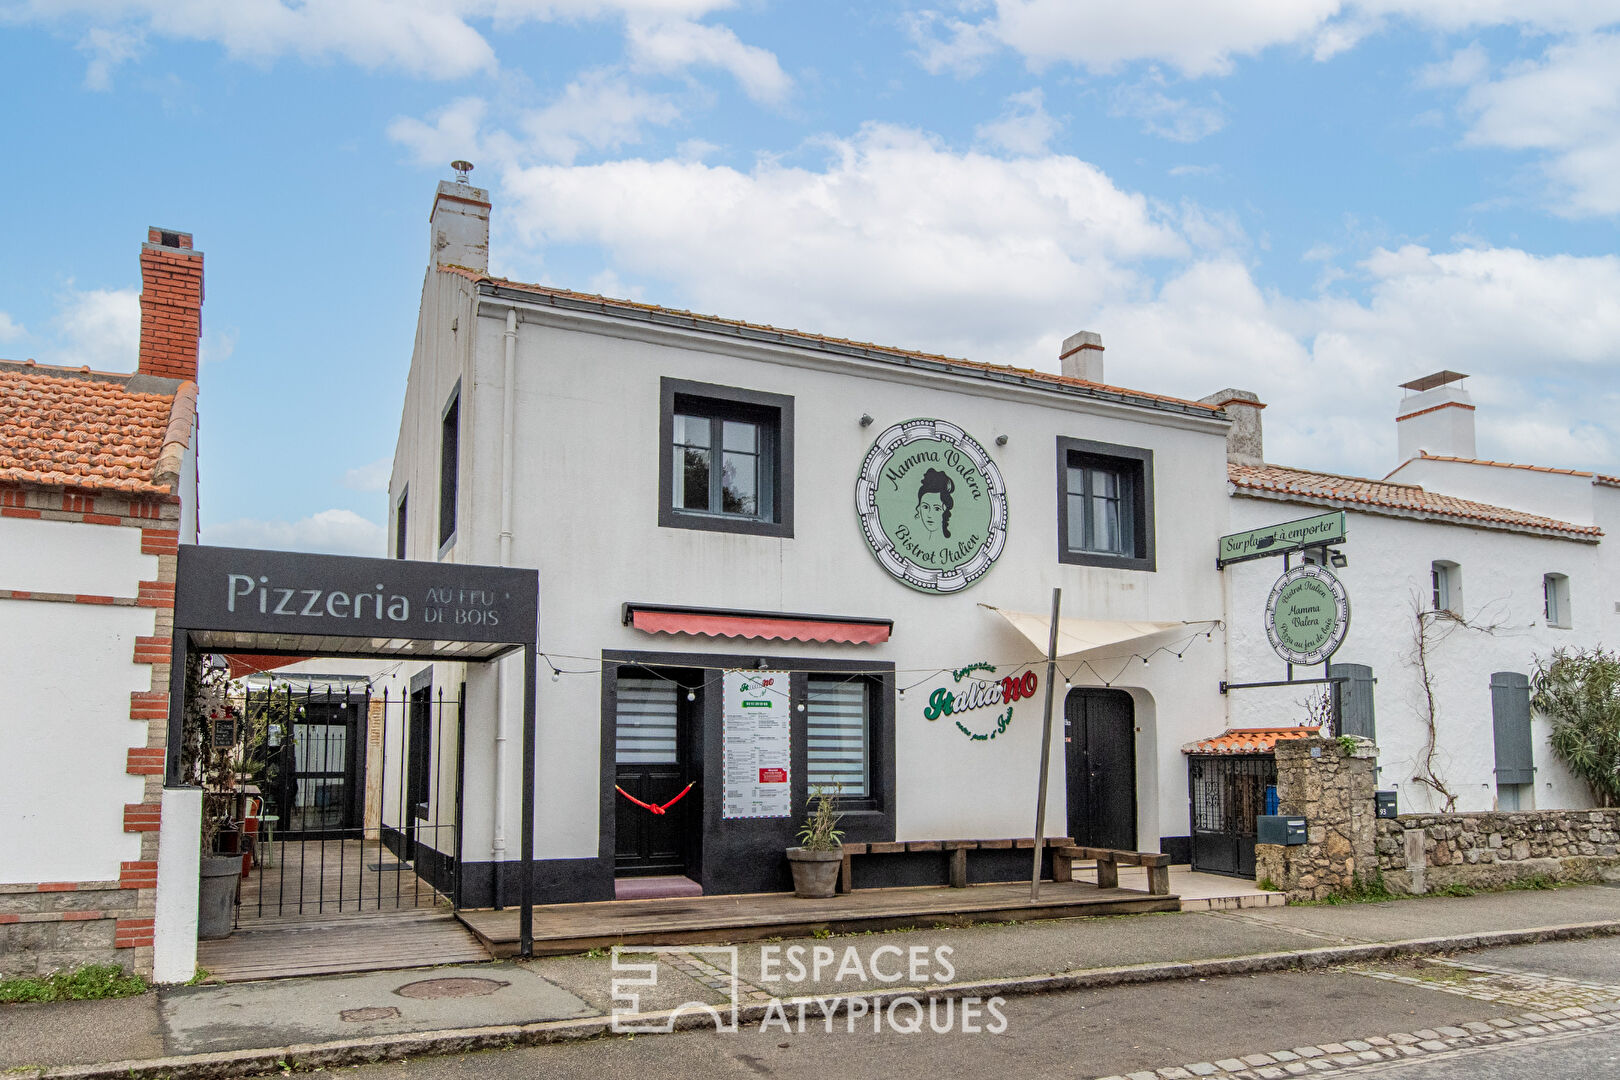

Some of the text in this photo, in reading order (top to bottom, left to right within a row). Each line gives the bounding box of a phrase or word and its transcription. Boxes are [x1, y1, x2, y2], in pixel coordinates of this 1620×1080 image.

[886, 449, 982, 501] Mamma Valera
[894, 524, 980, 565] Bistrot Italien
[1226, 538, 1243, 552] Sur
[1287, 520, 1335, 541] emporter
[227, 573, 410, 621] Pizzeria
[425, 587, 494, 606] AU FEU
[1282, 580, 1327, 604] Bistrot Italien
[424, 607, 499, 626] DE BOIS
[1288, 604, 1320, 616] Mamma
[1291, 616, 1319, 628] Valera
[1281, 623, 1293, 644] Pizza
[1304, 639, 1316, 651] feu
[1316, 633, 1324, 644] de
[1321, 618, 1332, 634] bois
[1379, 808, 1387, 816] 93
